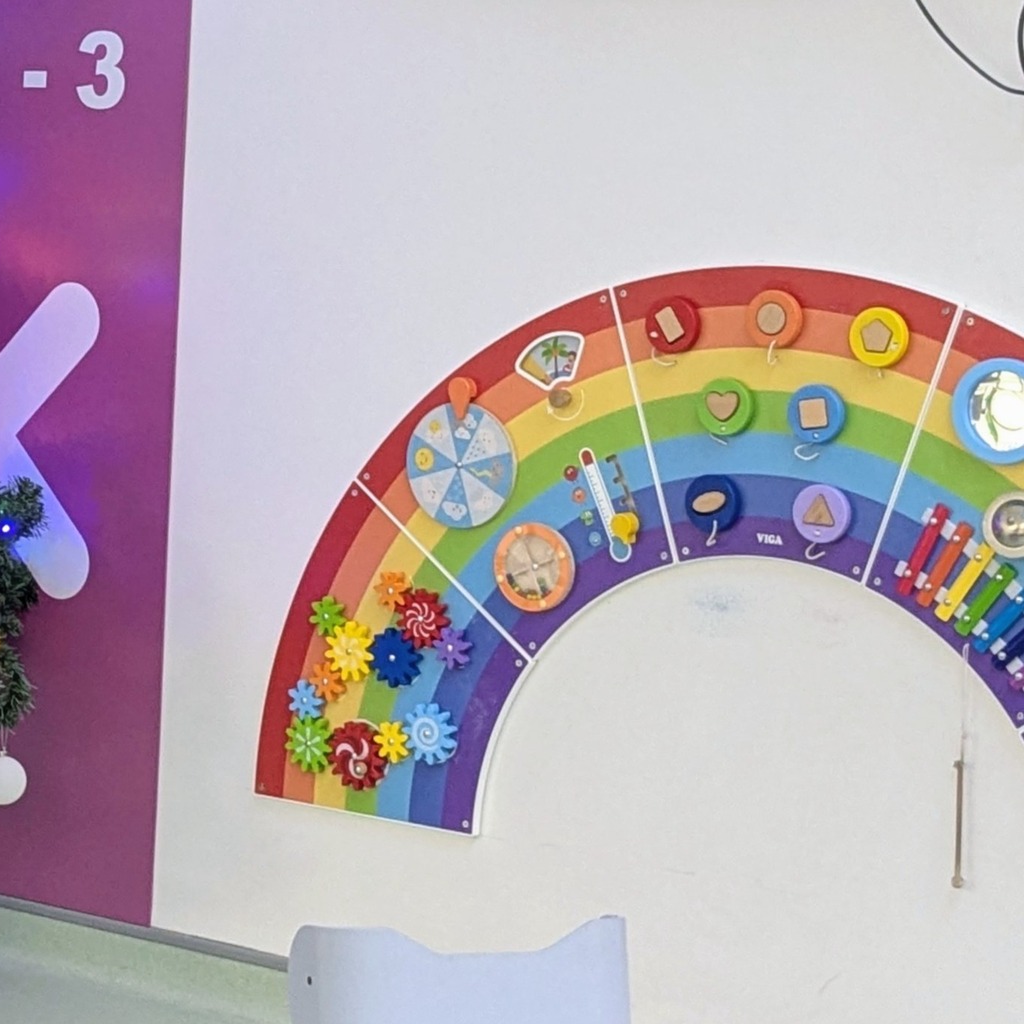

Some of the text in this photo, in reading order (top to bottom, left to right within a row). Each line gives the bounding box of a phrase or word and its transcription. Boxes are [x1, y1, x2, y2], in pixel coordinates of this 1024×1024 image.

[23, 70, 47, 88] -
[76, 30, 125, 110] 3
[756, 532, 784, 546] VIGA
